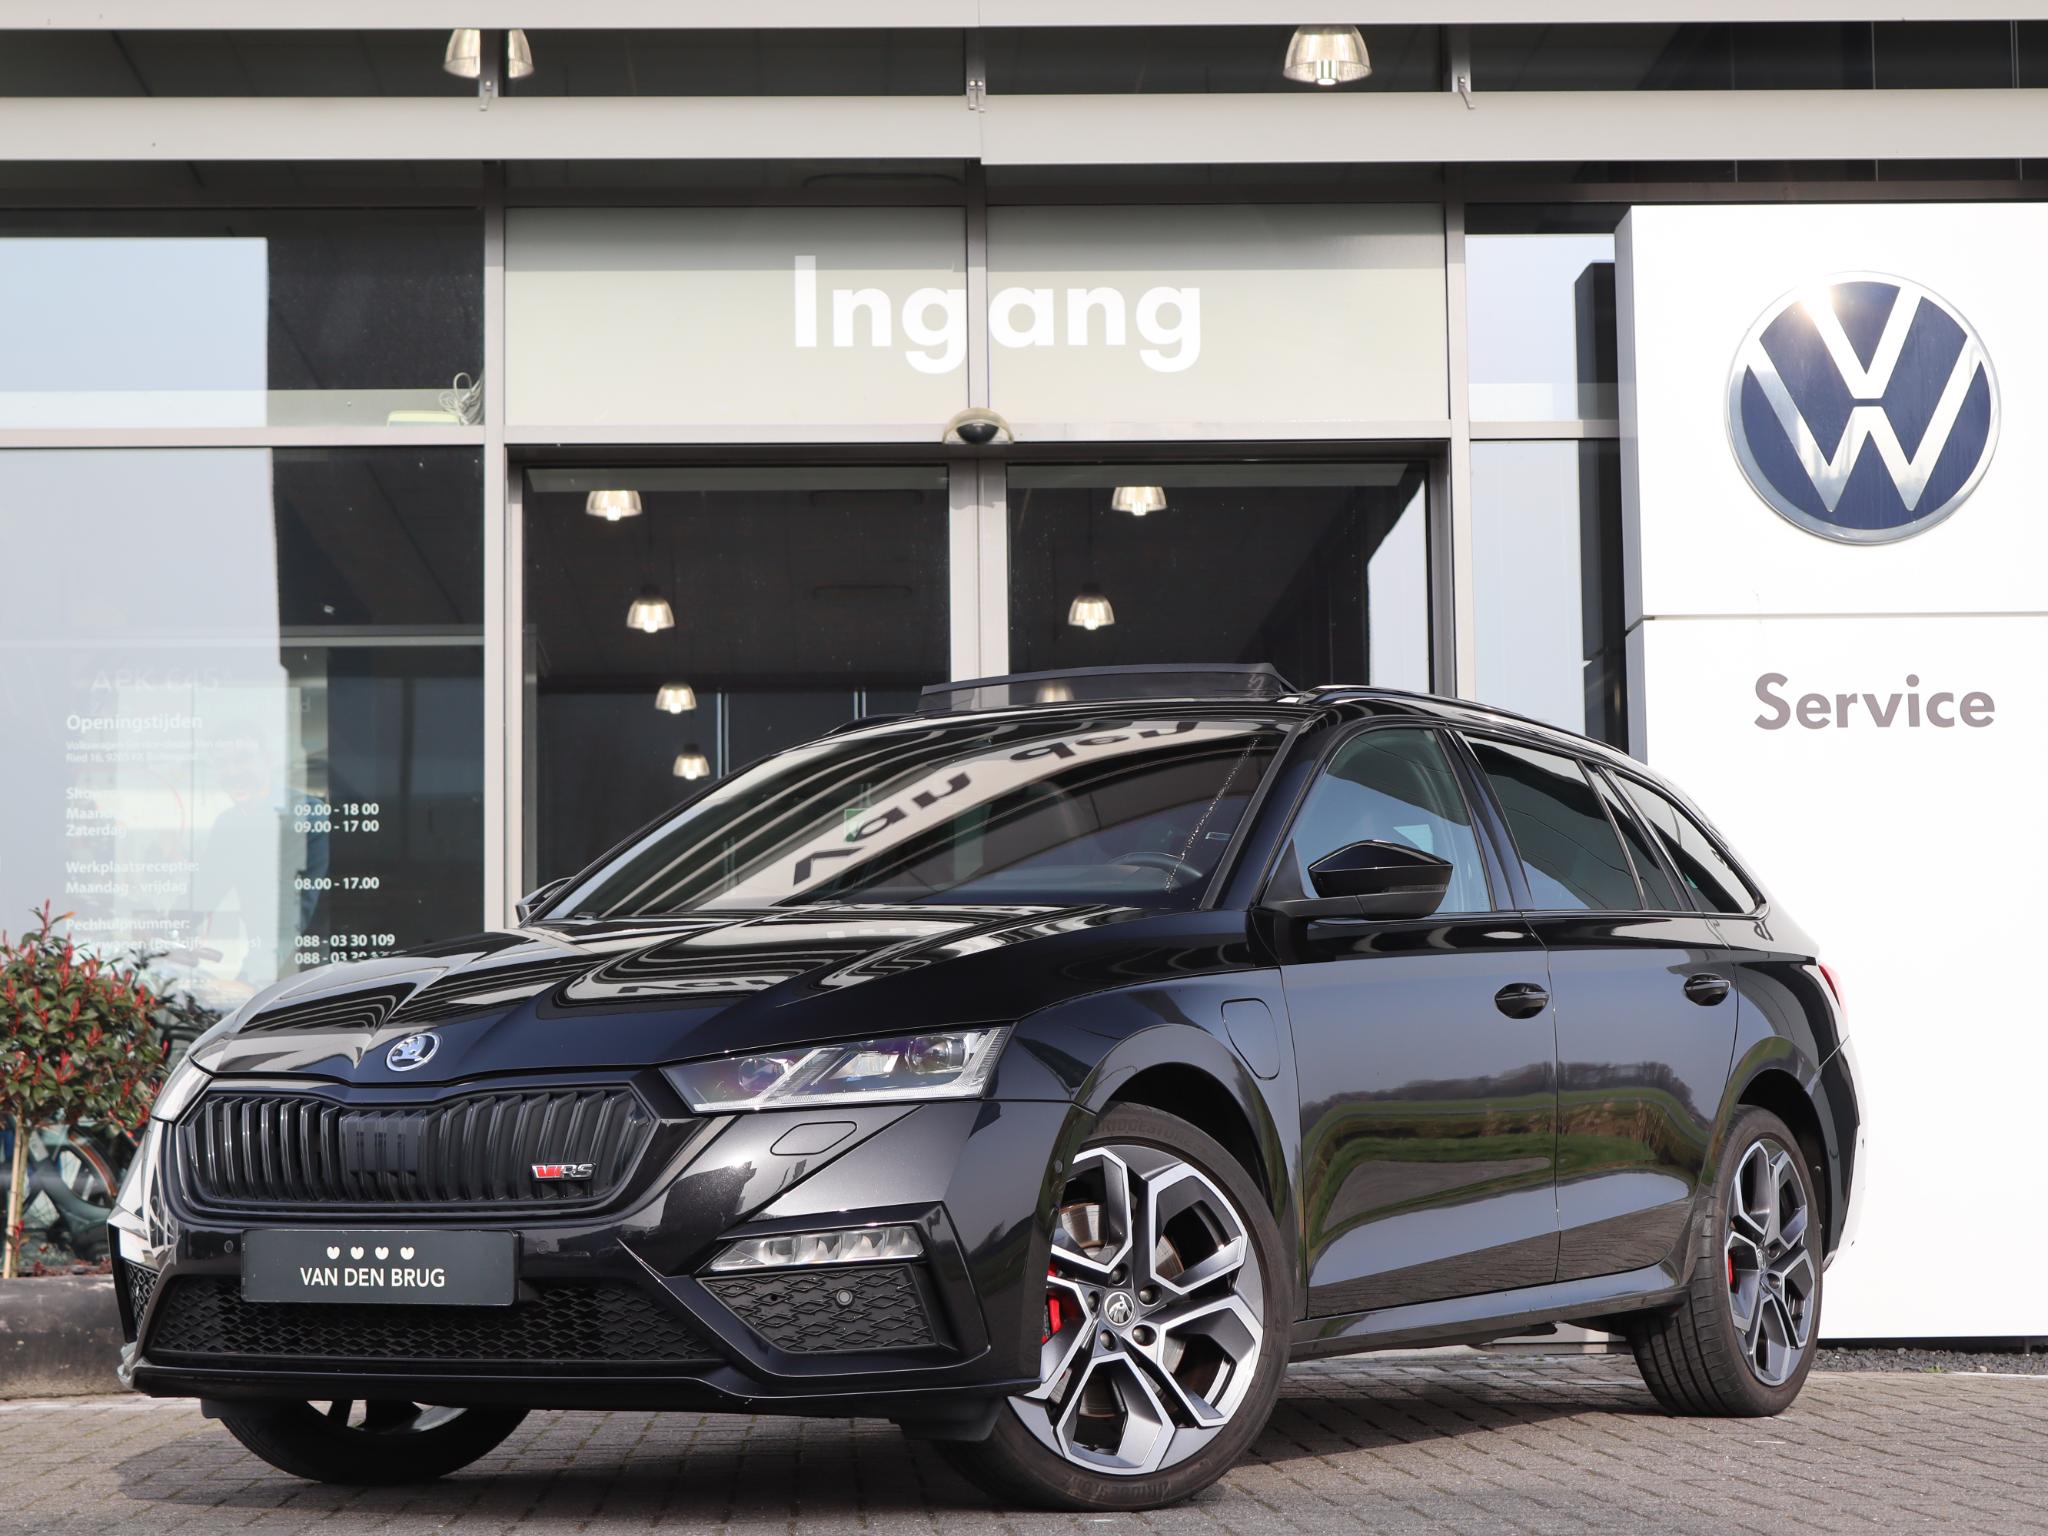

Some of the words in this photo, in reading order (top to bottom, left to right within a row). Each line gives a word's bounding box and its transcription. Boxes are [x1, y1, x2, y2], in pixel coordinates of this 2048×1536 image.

[794, 254, 1202, 375] Ingang
[1753, 672, 1995, 731] Service
[66, 713, 203, 733] Openingstijden
[294, 803, 331, 816] 09.00
[65, 823, 128, 840] Zaterdag
[294, 820, 331, 833] 09.00
[65, 881, 129, 897] Maandag
[140, 880, 188, 897] vrijdag
[294, 877, 331, 890] 08.00
[342, 877, 380, 890] 17.00
[294, 934, 320, 947] 088
[330, 934, 348, 947] 03
[350, 934, 368, 947] 30
[370, 934, 396, 946] 109
[294, 951, 320, 964] 088
[300, 1267, 338, 1286] VAN
[344, 1267, 385, 1287] DEN
[391, 1268, 446, 1288] BRUG
